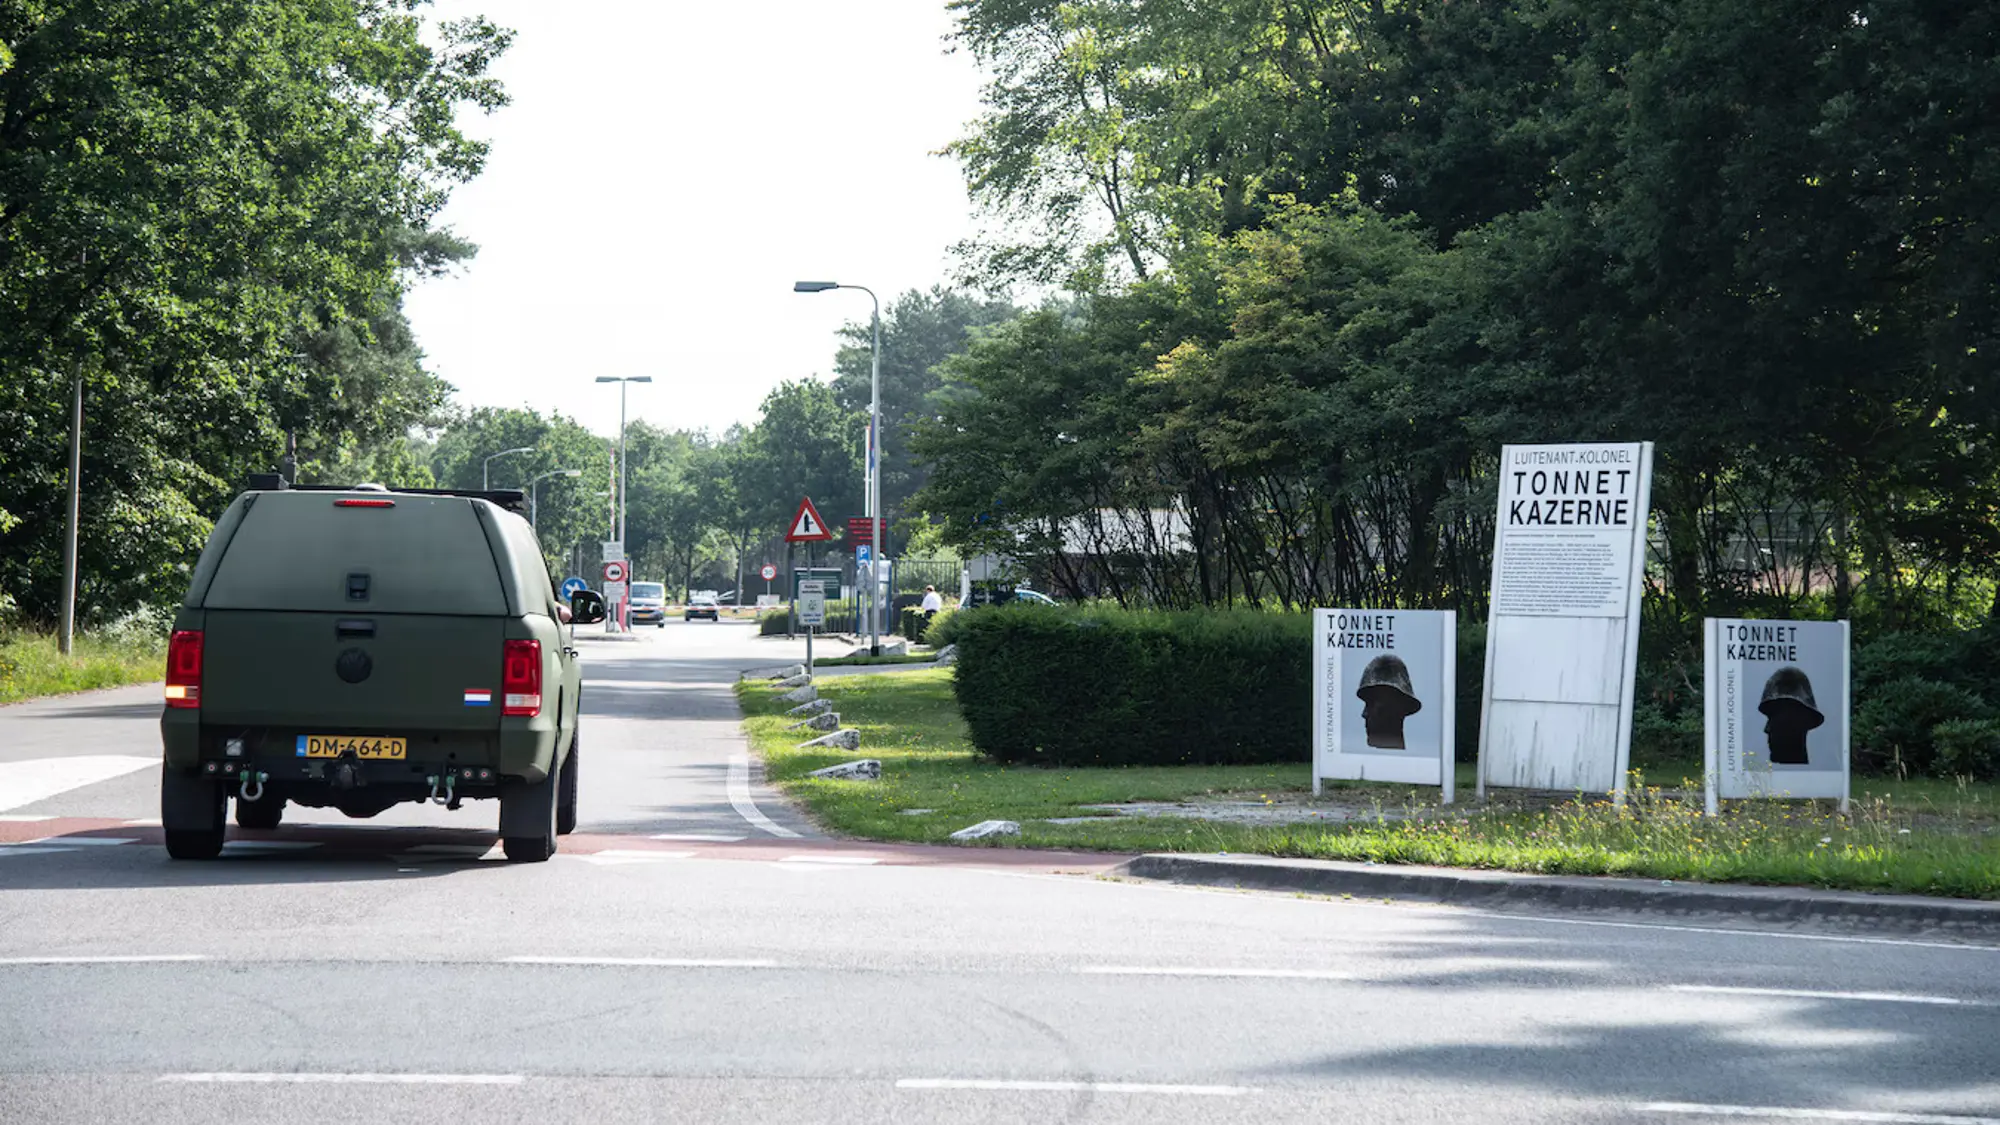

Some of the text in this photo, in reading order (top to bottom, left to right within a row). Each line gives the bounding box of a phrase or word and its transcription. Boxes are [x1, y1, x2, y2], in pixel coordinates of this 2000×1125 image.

[1513, 470, 1631, 496] TONNET
[1509, 499, 1629, 525] KAZERNE
[860, 547, 868, 558] P
[1327, 614, 1395, 631] TONNET
[1327, 632, 1395, 649] KAZERNE
[1726, 625, 1797, 643] TONNET
[1726, 644, 1797, 662] KAZERNE
[309, 738, 403, 757] DM-664-D
